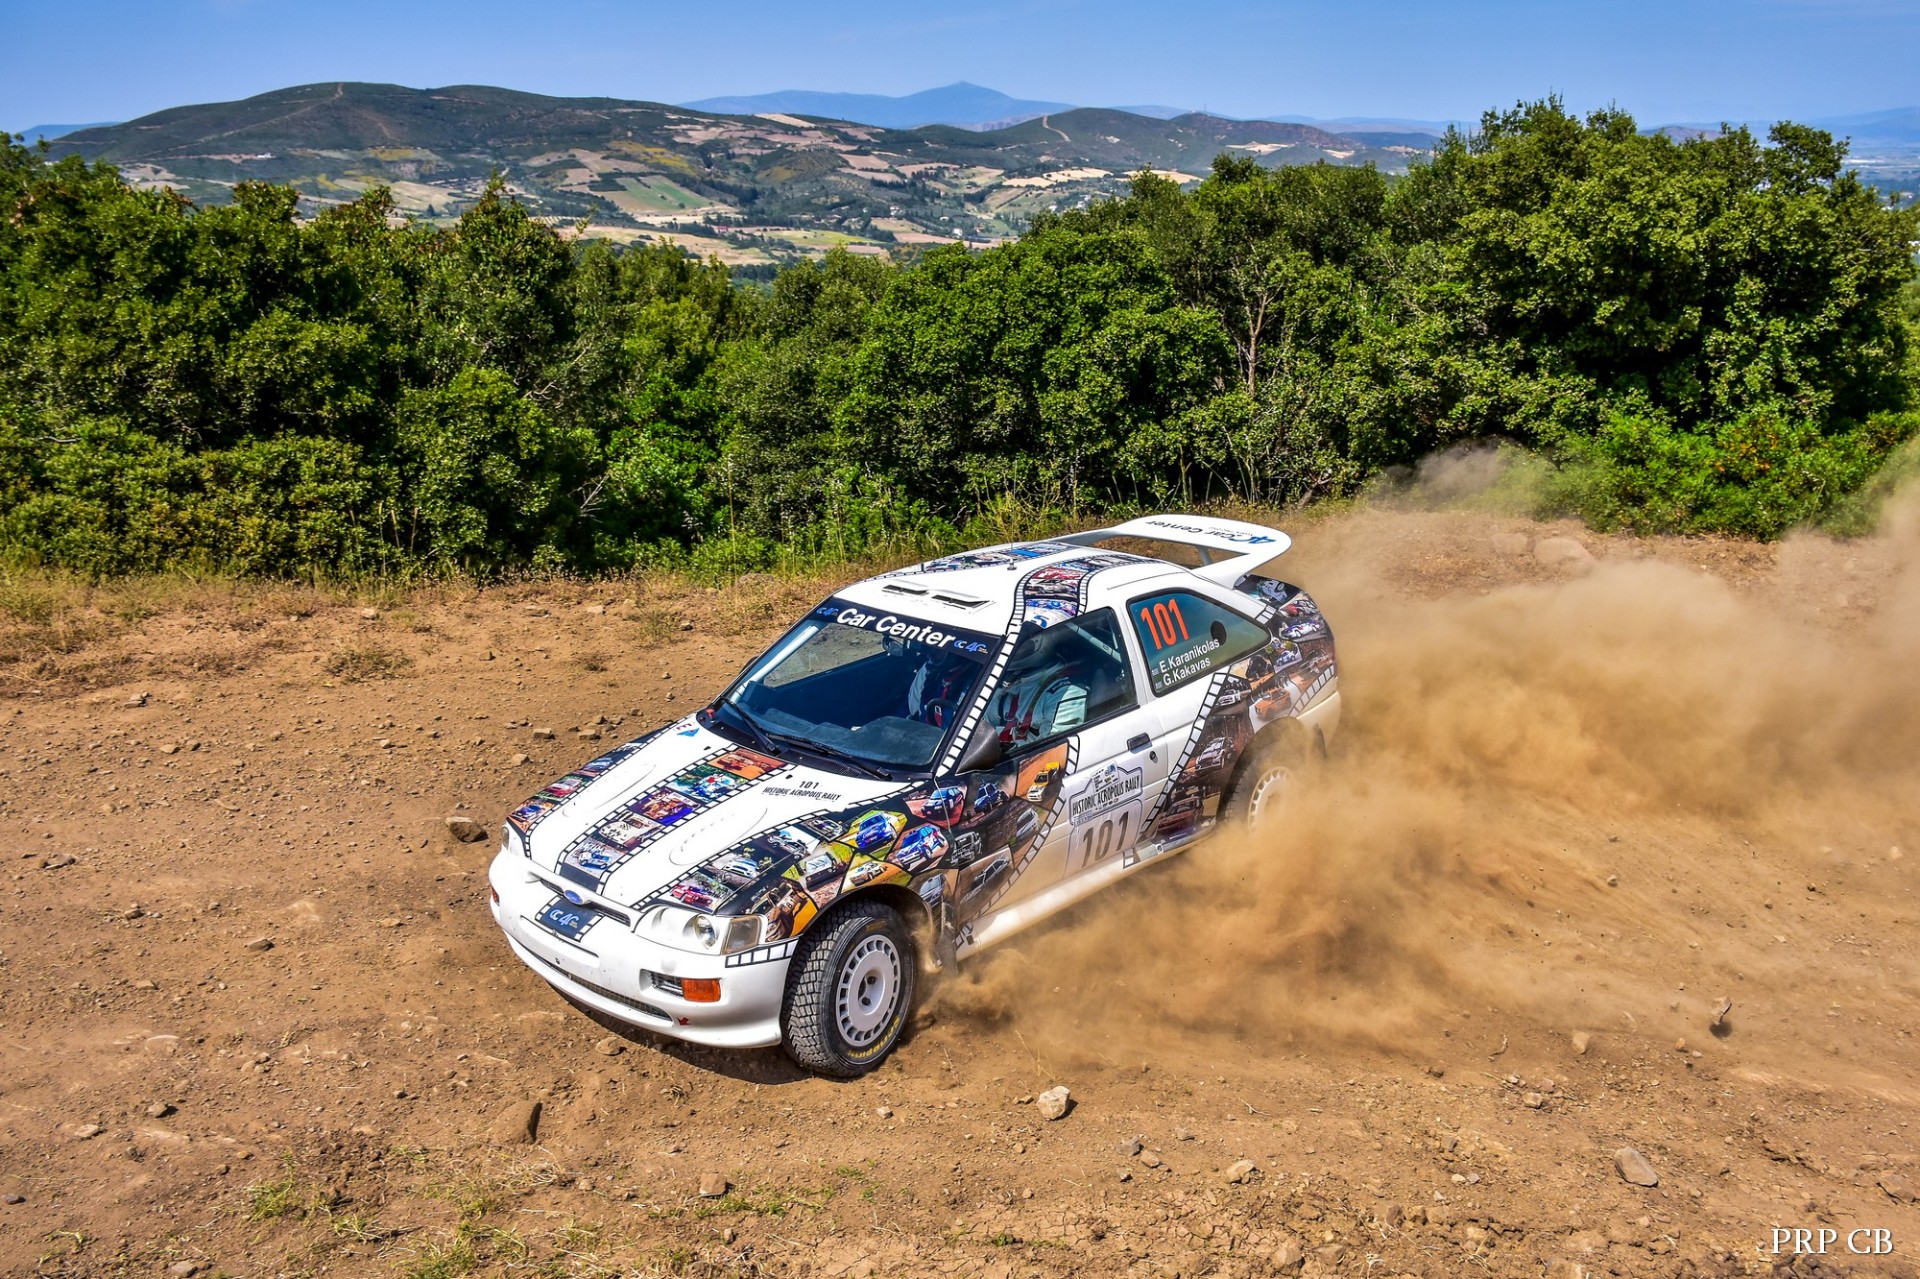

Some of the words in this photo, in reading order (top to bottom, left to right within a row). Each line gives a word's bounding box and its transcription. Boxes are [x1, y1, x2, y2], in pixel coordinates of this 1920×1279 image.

[1145, 520, 1203, 533] Center
[1205, 529, 1235, 539] Car
[836, 608, 876, 627] Car
[875, 615, 956, 648] Center
[1140, 598, 1190, 650] 101
[1158, 638, 1220, 673] E.Karanikolas
[1163, 657, 1211, 686] G.Kakavas
[762, 786, 791, 795] HISTORIC
[790, 789, 822, 798] ACROPOLIS
[821, 792, 842, 801] RALLY
[798, 780, 820, 790] 101
[1072, 794, 1098, 816] HISTORIC
[1097, 782, 1124, 805] ACROPOLIS
[1125, 775, 1140, 793] RALLY
[1081, 810, 1129, 869] 101
